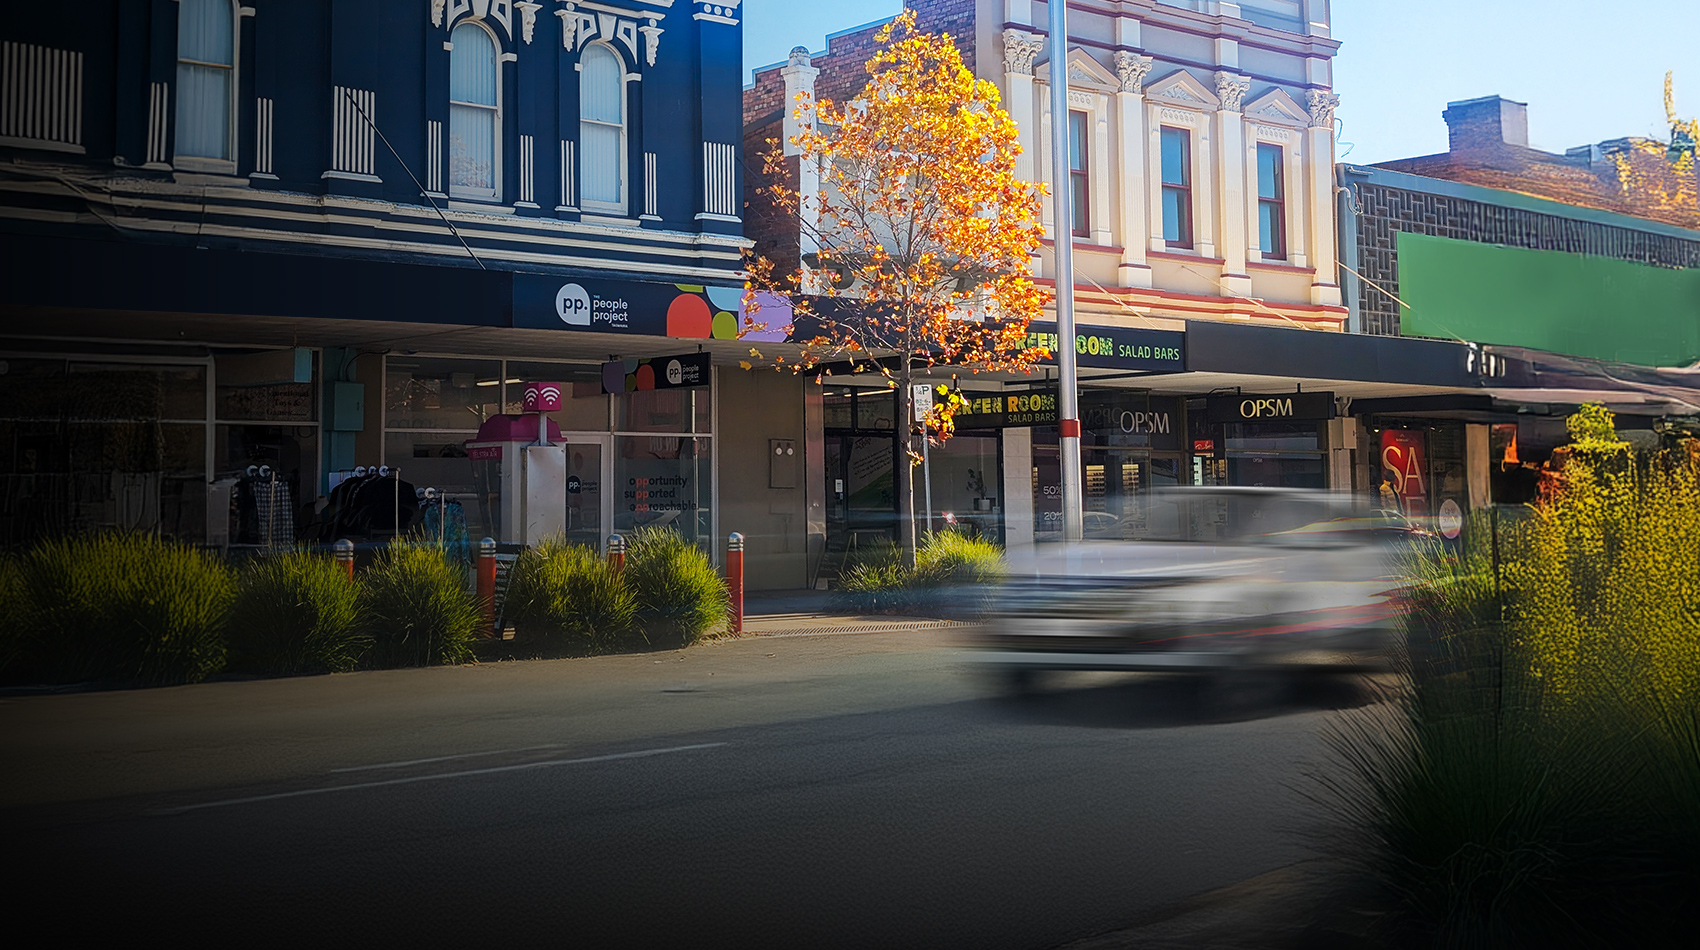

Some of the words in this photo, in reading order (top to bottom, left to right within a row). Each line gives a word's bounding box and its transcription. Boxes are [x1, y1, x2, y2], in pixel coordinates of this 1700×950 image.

[563, 297, 588, 314] pp.
[593, 298, 628, 312] people
[593, 311, 628, 324] project
[1076, 335, 1113, 356] OOM
[1119, 344, 1151, 359] SALAD
[1154, 347, 1180, 361] BARS
[683, 364, 699, 374] people
[683, 373, 699, 381] project
[1007, 394, 1055, 413] ROOM
[1240, 398, 1293, 418] OPSM
[1008, 414, 1033, 423] SALAD
[1034, 412, 1056, 422] BARS
[1120, 410, 1170, 434] OPSM
[629, 475, 688, 488] opportunity
[624, 488, 676, 500] supported
